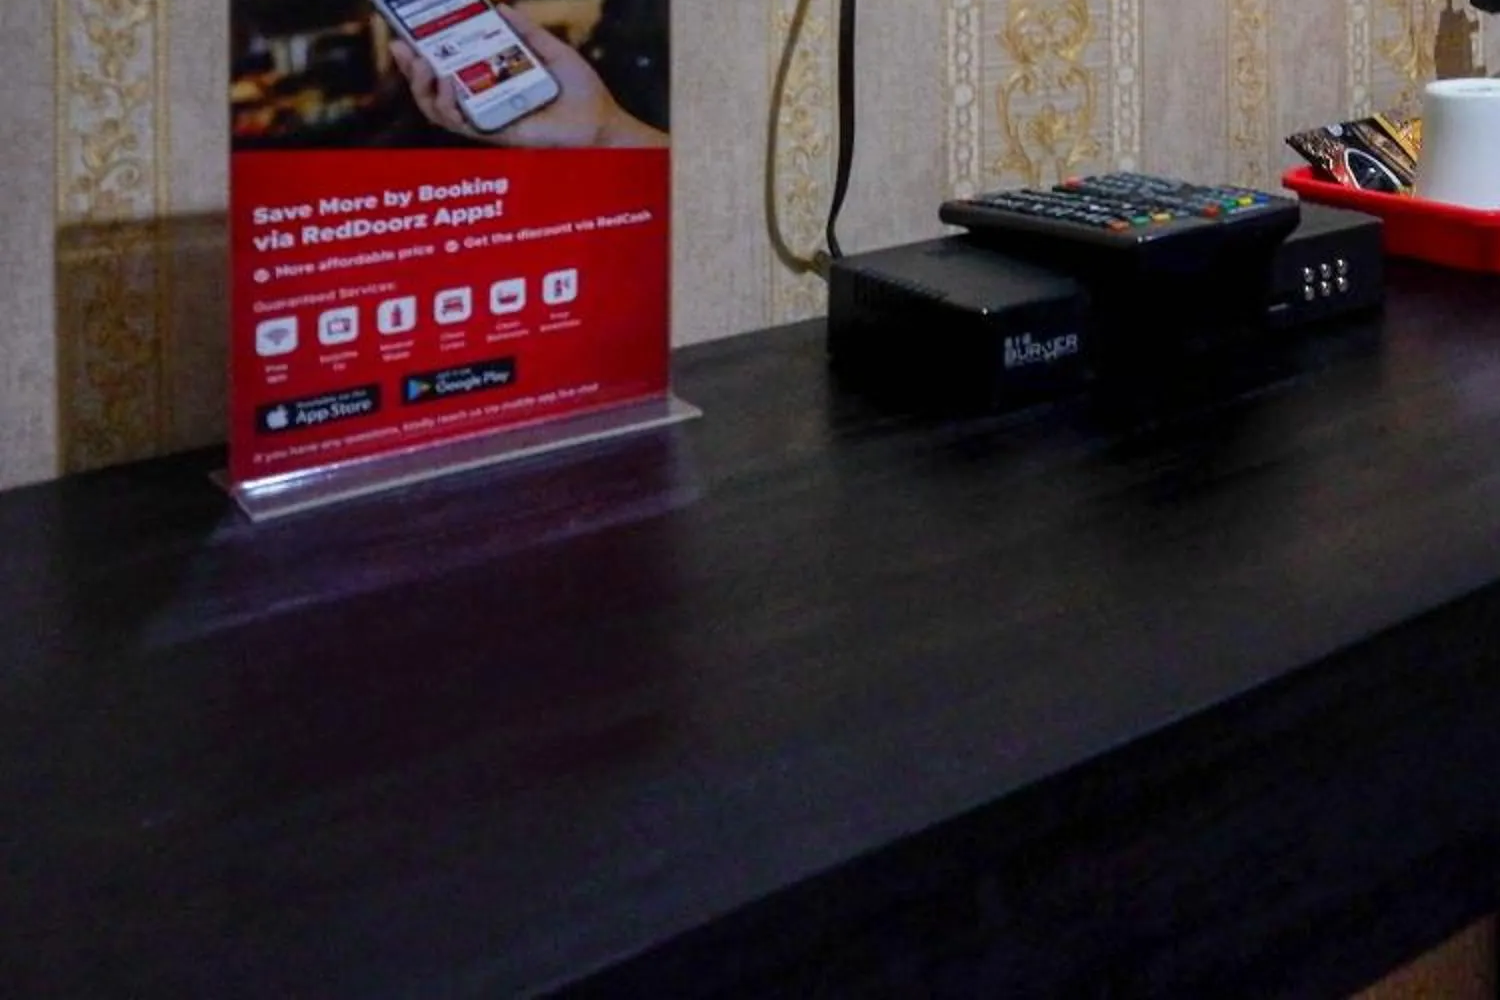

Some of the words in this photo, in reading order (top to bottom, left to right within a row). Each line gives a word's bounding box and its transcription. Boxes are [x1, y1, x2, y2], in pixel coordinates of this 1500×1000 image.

[253, 204, 313, 225] Save
[319, 196, 378, 216] More
[383, 189, 413, 208] by
[418, 177, 509, 201] Booking
[253, 230, 295, 252] via
[302, 213, 428, 244] RedDoorz
[433, 199, 504, 227] Apps!
[464, 235, 488, 249] Get
[491, 230, 513, 244] the
[516, 222, 573, 242] discount
[275, 262, 315, 279] More
[318, 250, 396, 271] affordable
[398, 243, 435, 260] price
[436, 373, 482, 393] Google
[483, 369, 511, 386] Play
[296, 405, 329, 425] App
[330, 398, 373, 417] Store
